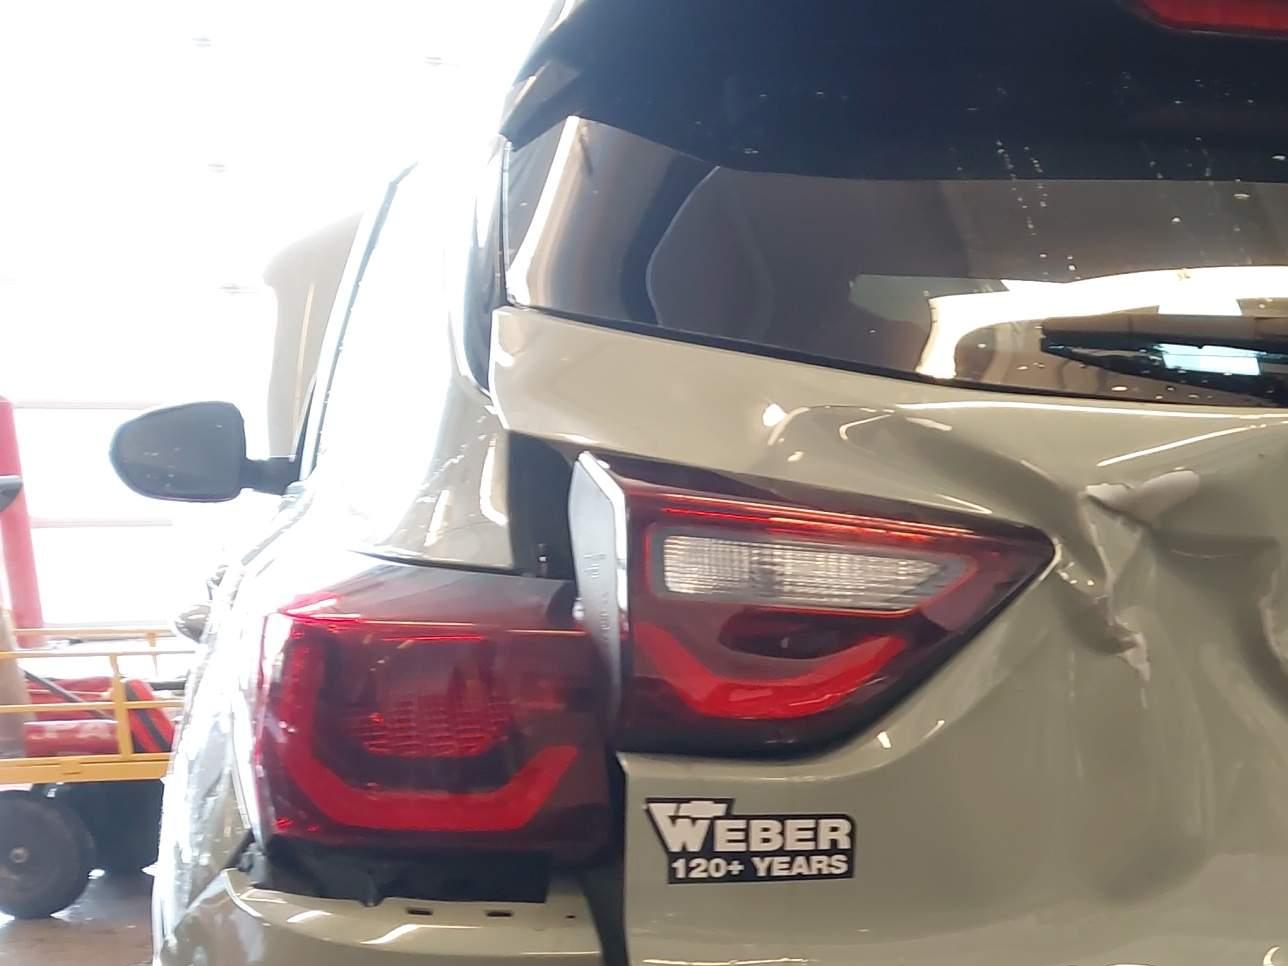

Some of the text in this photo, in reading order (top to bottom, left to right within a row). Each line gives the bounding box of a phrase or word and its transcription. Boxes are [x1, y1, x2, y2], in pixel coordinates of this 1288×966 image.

[647, 801, 852, 852] WEBER
[671, 854, 849, 879] 120+ YEARS
